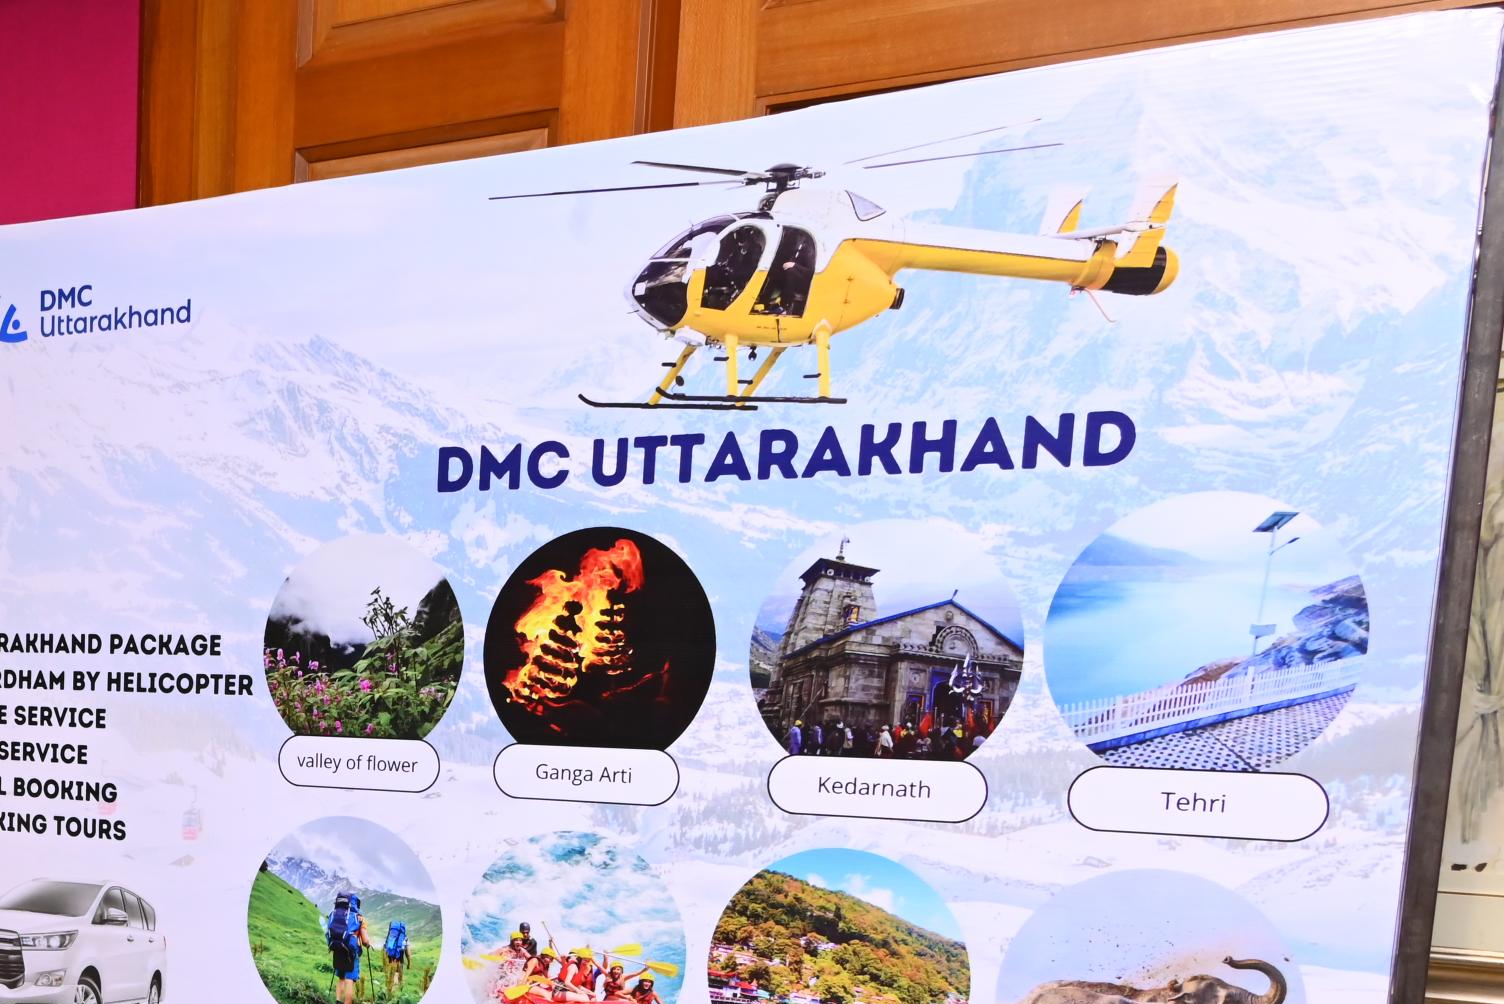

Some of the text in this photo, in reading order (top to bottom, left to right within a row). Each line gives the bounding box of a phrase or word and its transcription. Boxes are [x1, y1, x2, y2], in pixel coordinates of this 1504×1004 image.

[40, 285, 93, 312] DMC
[39, 298, 192, 338] Uttarakhand
[437, 410, 1137, 493] DMC UTTARAKHAND
[110, 633, 222, 656] PACKAGE
[72, 671, 101, 691] BY
[107, 672, 254, 696] HELICOPTER
[14, 705, 107, 729] SERVICE
[296, 753, 418, 774] valley of flower
[535, 763, 633, 787] Ganga Arti
[13, 777, 118, 804] BOOKING
[817, 776, 932, 800] Kedarnath
[1160, 791, 1227, 814] Tehri
[53, 816, 127, 841] TOURS
